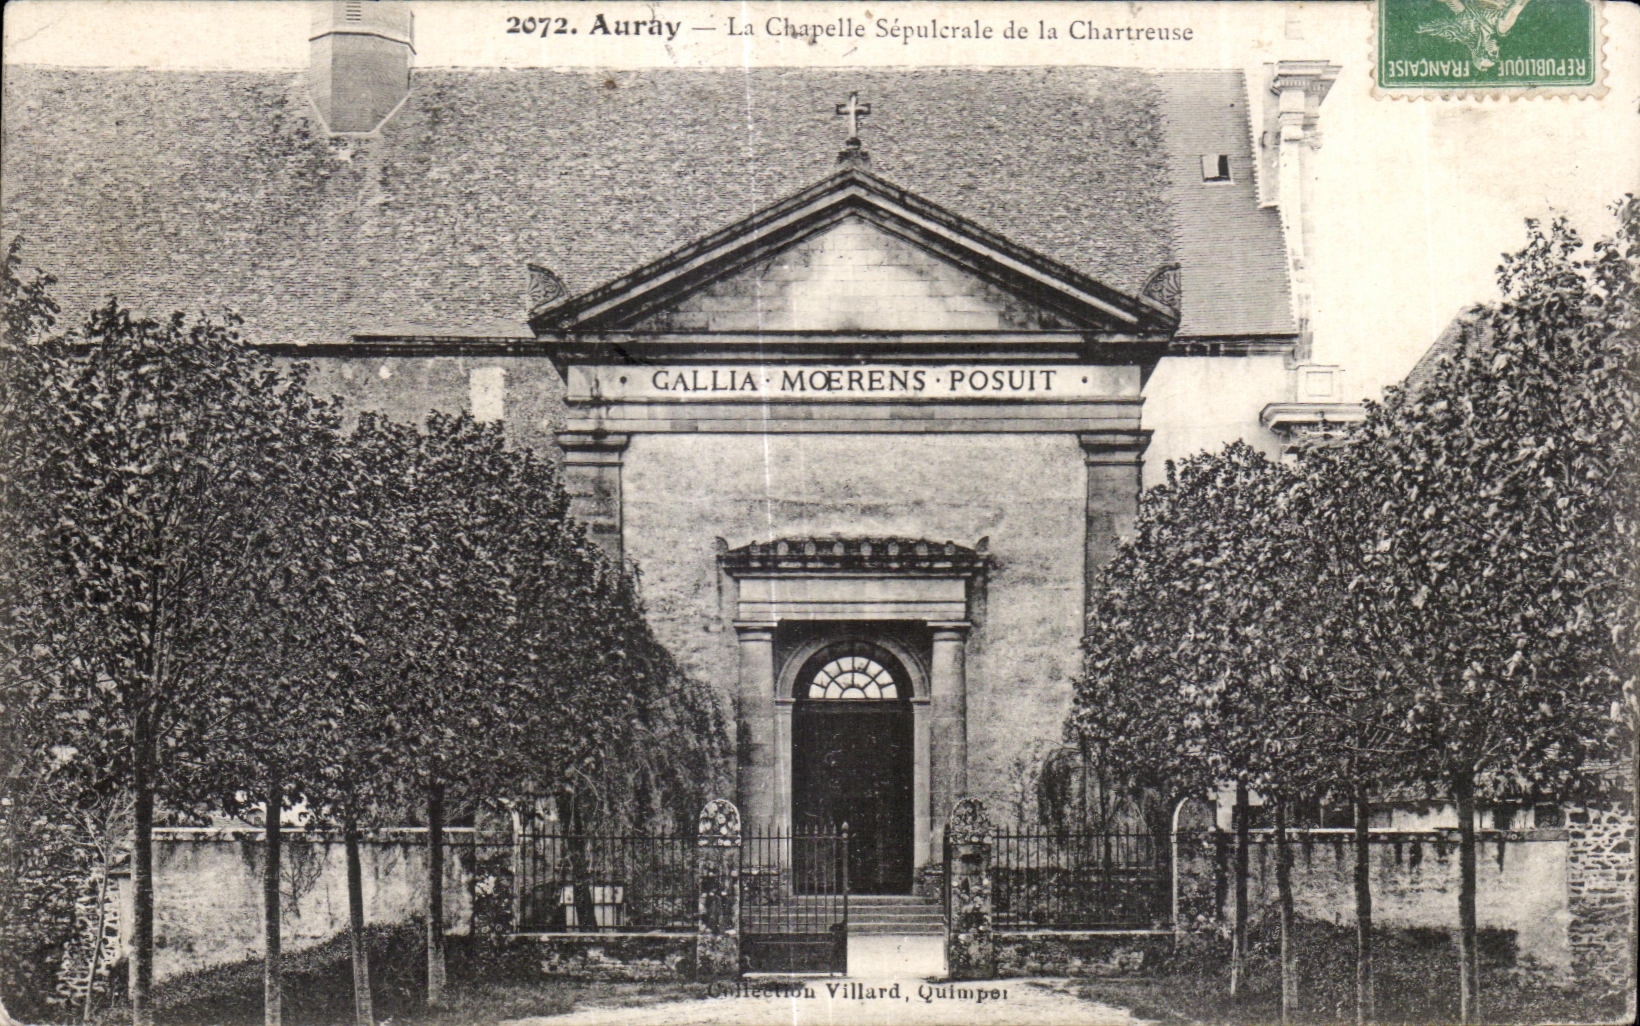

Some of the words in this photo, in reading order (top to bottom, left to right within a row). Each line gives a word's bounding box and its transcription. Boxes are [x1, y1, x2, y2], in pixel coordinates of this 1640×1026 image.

[1388, 58, 1470, 77] FRANÇAISE
[652, 370, 760, 392] GALLIA
[949, 370, 1058, 392] POSUIT
